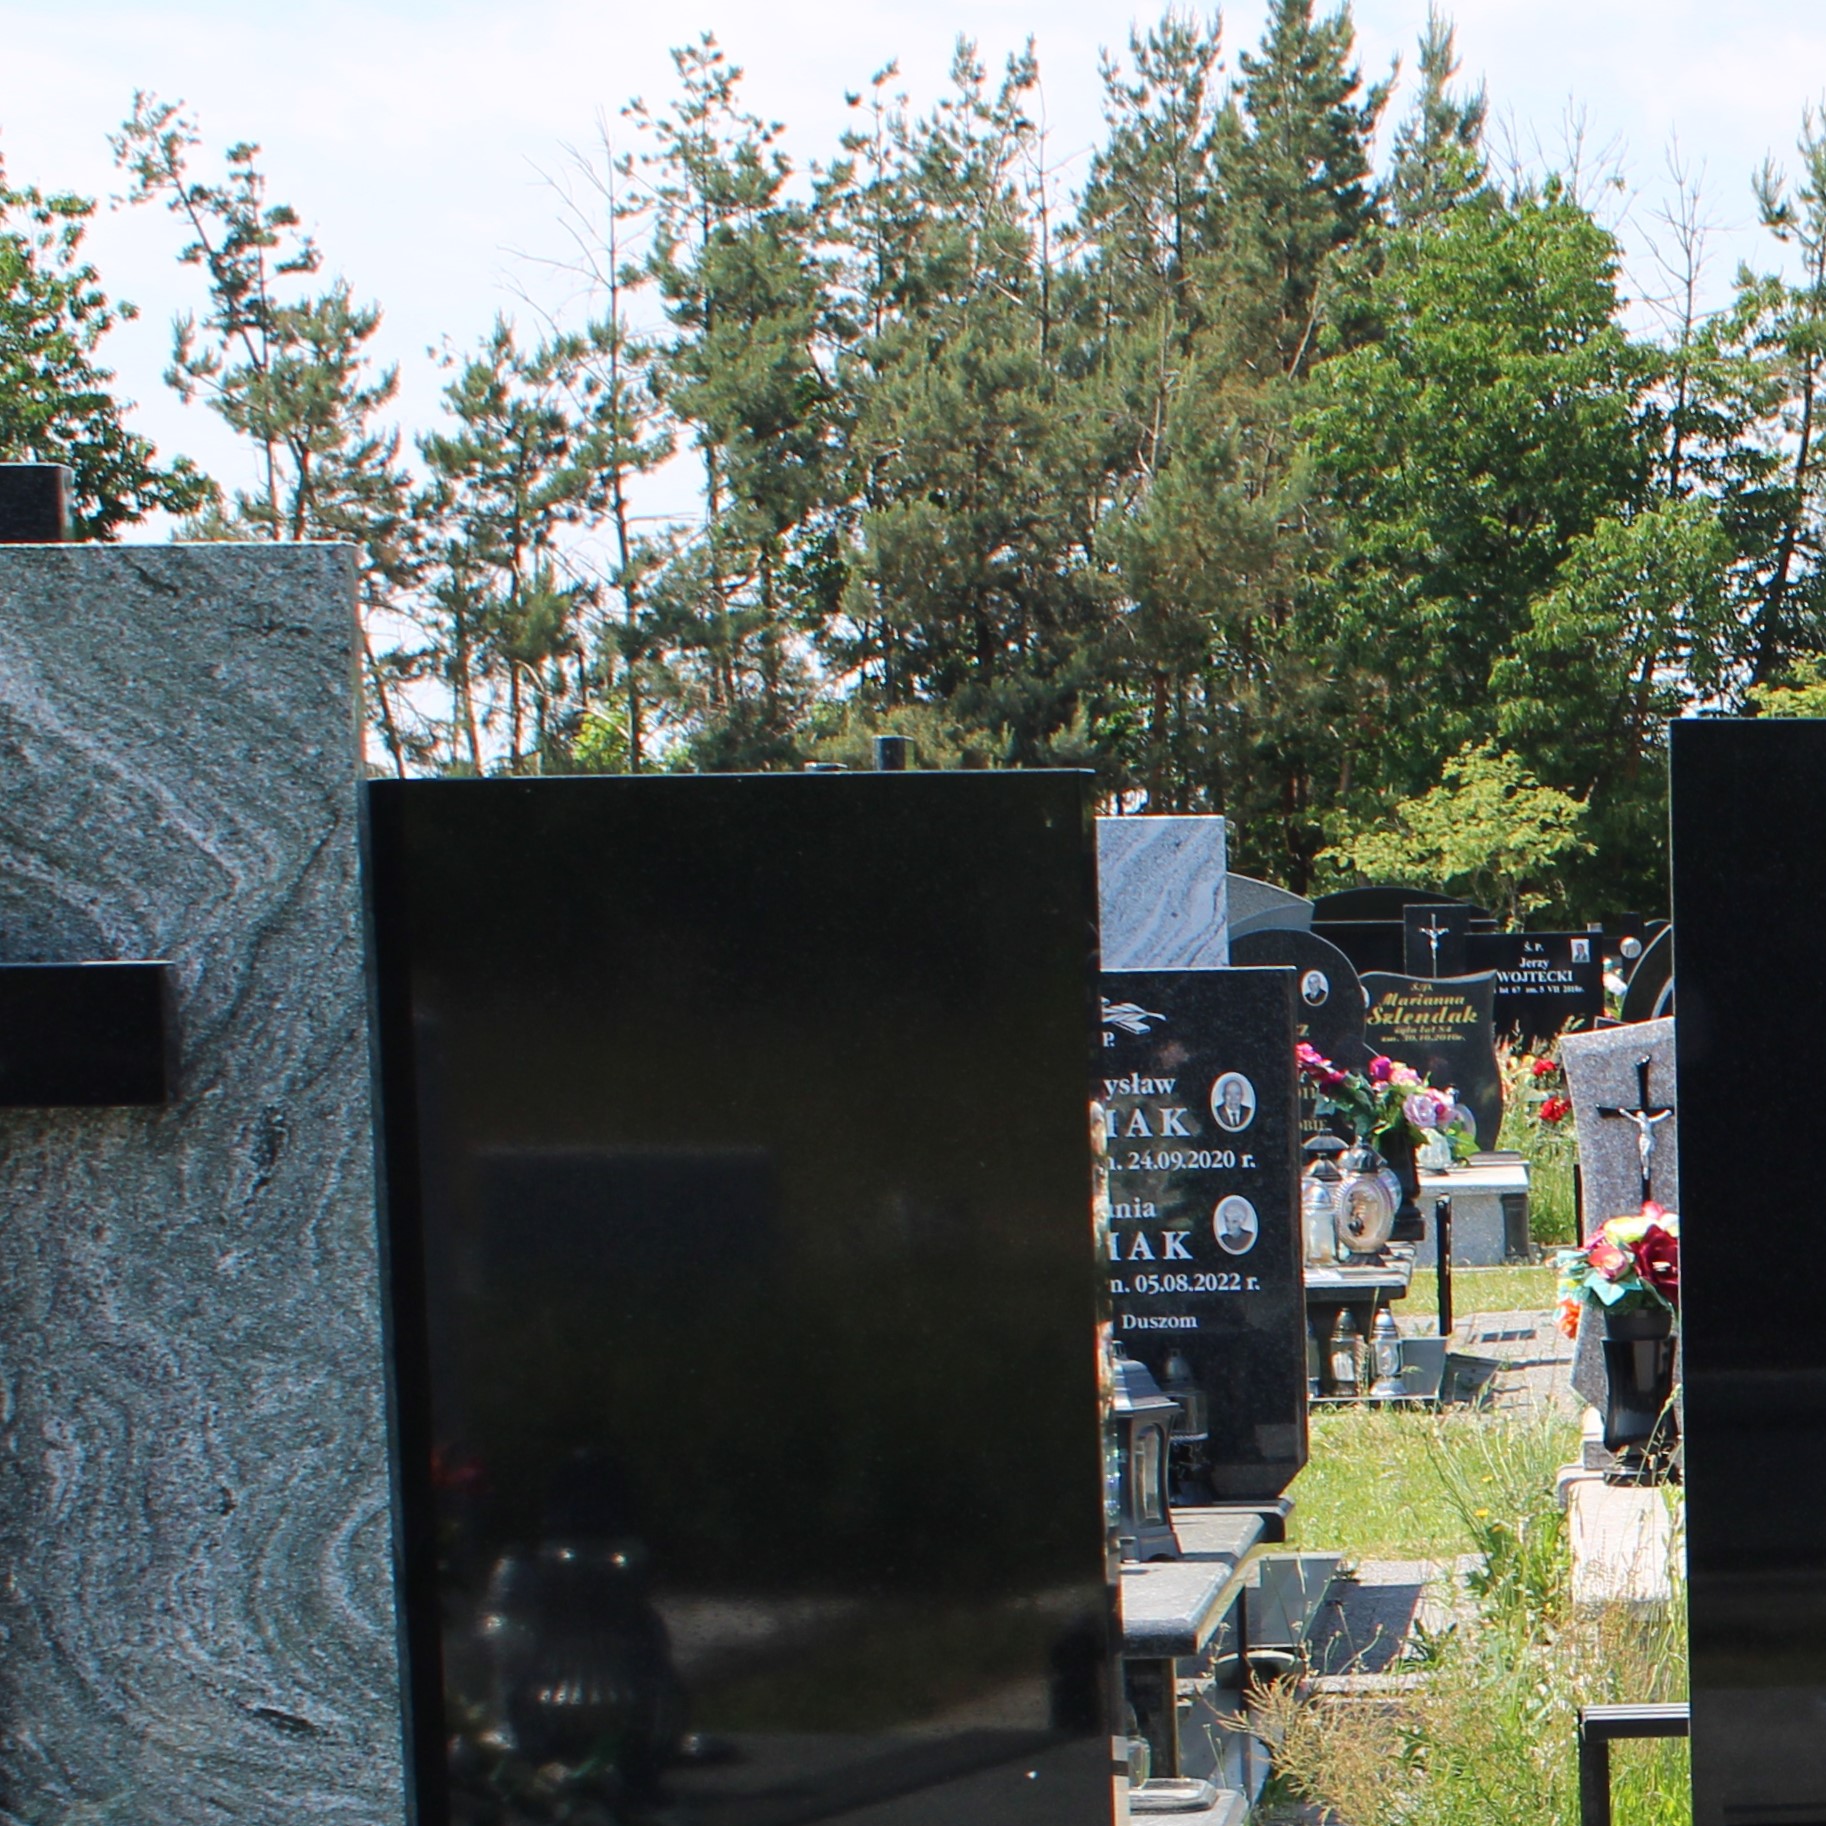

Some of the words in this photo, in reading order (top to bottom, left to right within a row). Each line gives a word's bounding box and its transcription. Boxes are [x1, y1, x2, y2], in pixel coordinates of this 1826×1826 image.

[1519, 957, 1550, 970] Jerzy
[1496, 970, 1574, 983] WOJTECKI
[1382, 992, 1465, 1007] Marianna
[1366, 1005, 1478, 1025] Szlendak
[1128, 1150, 1235, 1171] 24.09.2020
[1241, 1153, 1256, 1169] r.
[1135, 1273, 1241, 1294] 05.08.2022
[1247, 1275, 1260, 1291] r.
[1121, 1314, 1198, 1330] Duszom
